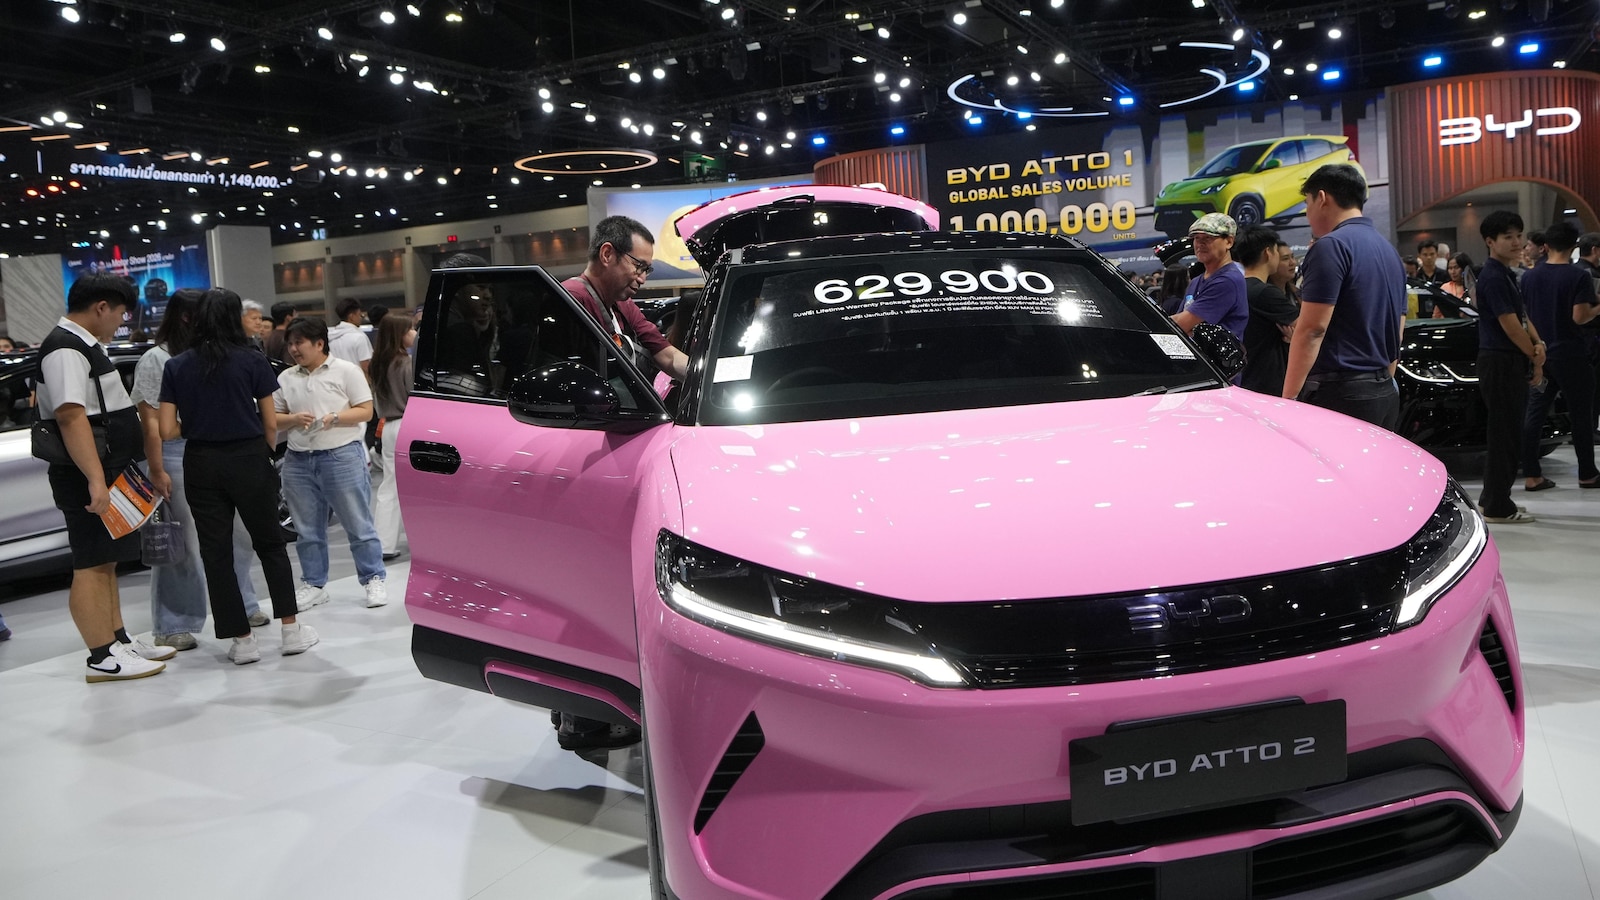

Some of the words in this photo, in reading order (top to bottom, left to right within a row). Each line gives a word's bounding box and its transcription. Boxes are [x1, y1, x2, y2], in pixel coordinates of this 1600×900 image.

[1439, 106, 1581, 146] BYD
[947, 163, 1011, 185] BYD
[1021, 151, 1111, 177] ATTO
[1123, 149, 1133, 167] 1
[949, 186, 1009, 204] GLOBAL
[1011, 180, 1062, 198] SALES
[1064, 173, 1132, 192] VOLUME
[1112, 232, 1136, 240] UNITS
[815, 305, 845, 314] Lifetime
[845, 302, 879, 311] Warranty
[879, 299, 911, 307] Package
[1127, 594, 1252, 634] BYD
[1104, 758, 1177, 786] BYD
[1189, 742, 1282, 772] ATTO
[1293, 736, 1316, 755] 2
